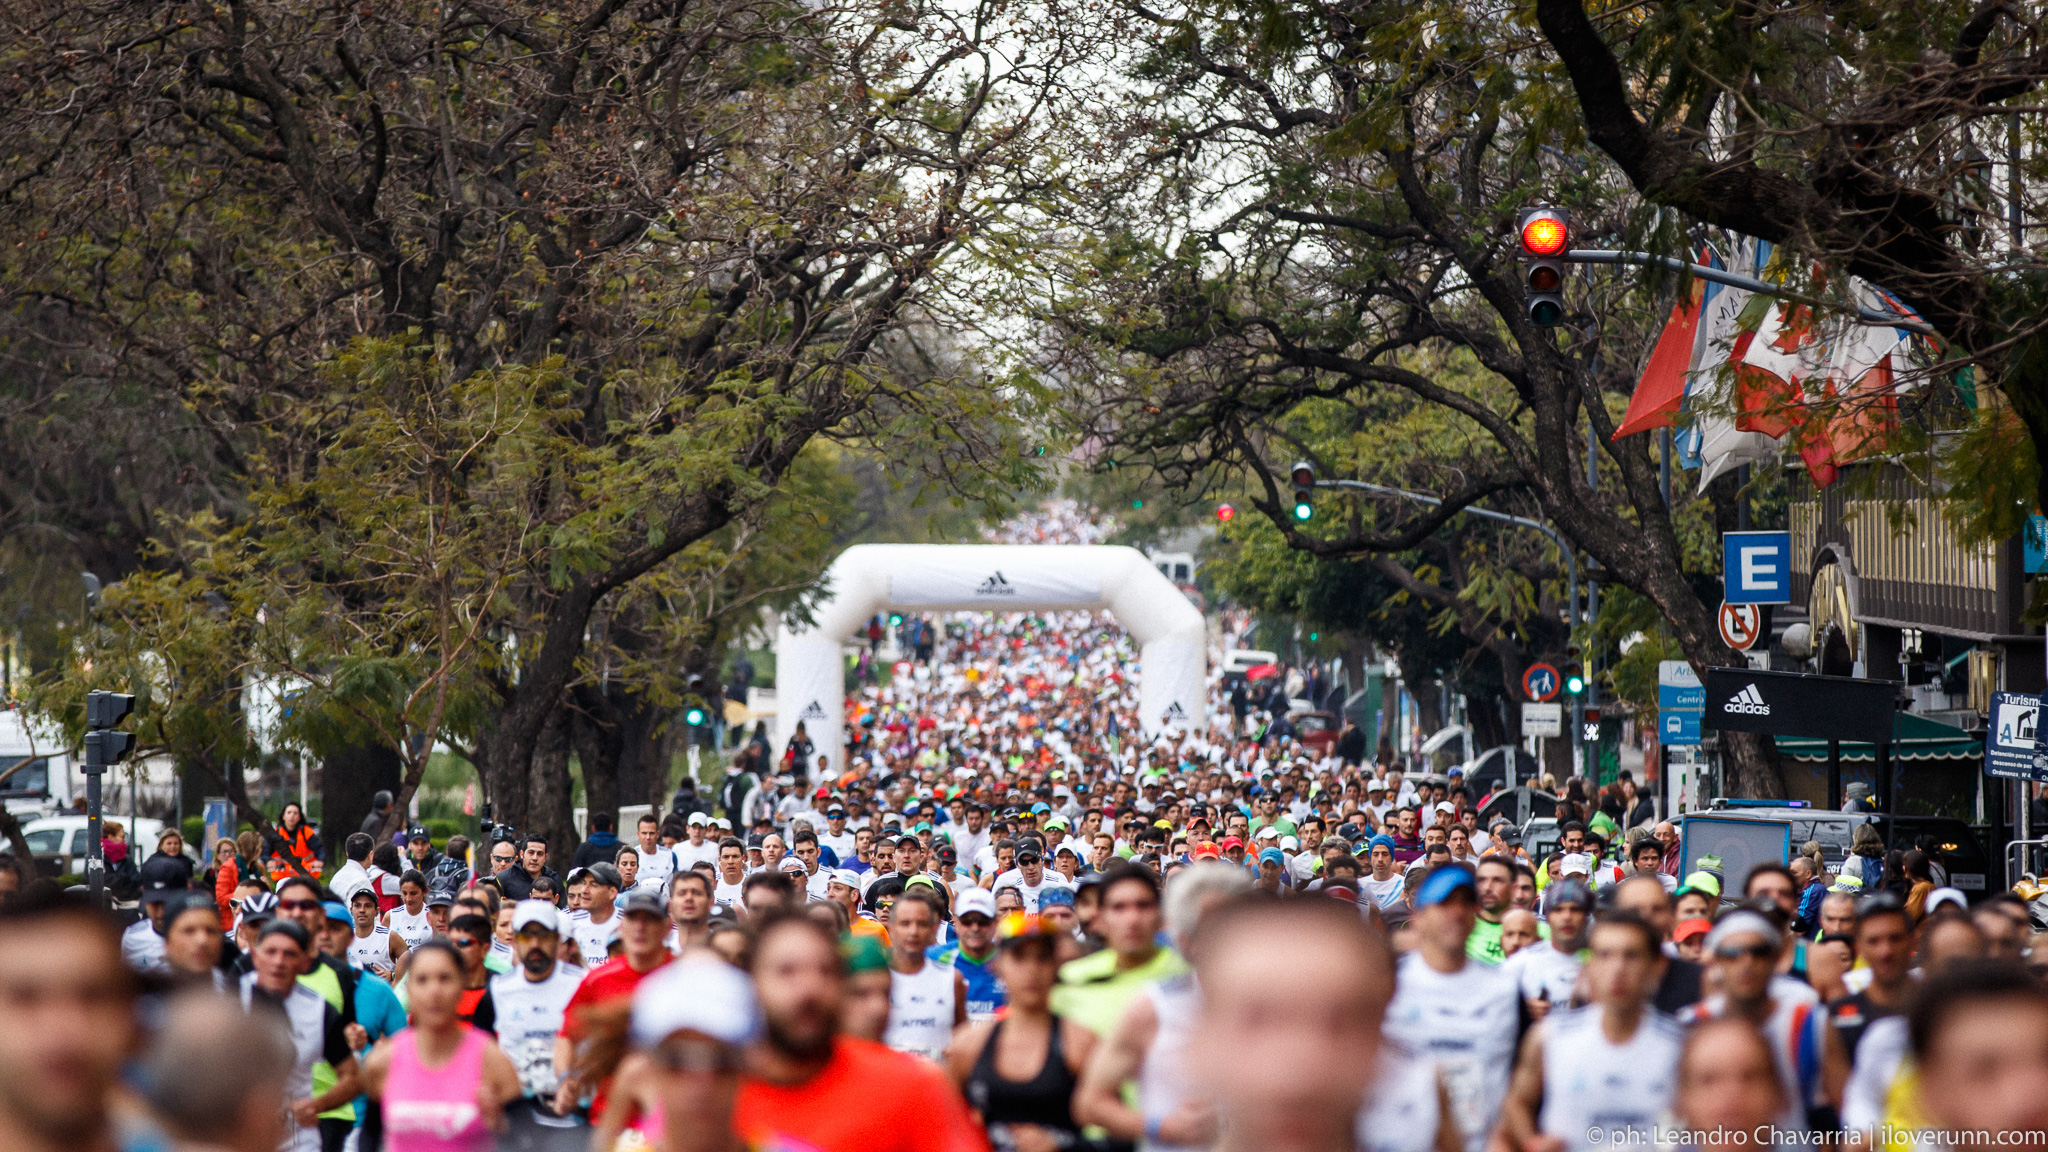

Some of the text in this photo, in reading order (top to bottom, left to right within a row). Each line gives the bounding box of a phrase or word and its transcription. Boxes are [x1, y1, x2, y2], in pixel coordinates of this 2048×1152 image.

[1741, 546, 1778, 590] E
[2003, 693, 2041, 707] Turism
[1723, 702, 1770, 716] adidas
[588, 956, 608, 965] rnet
